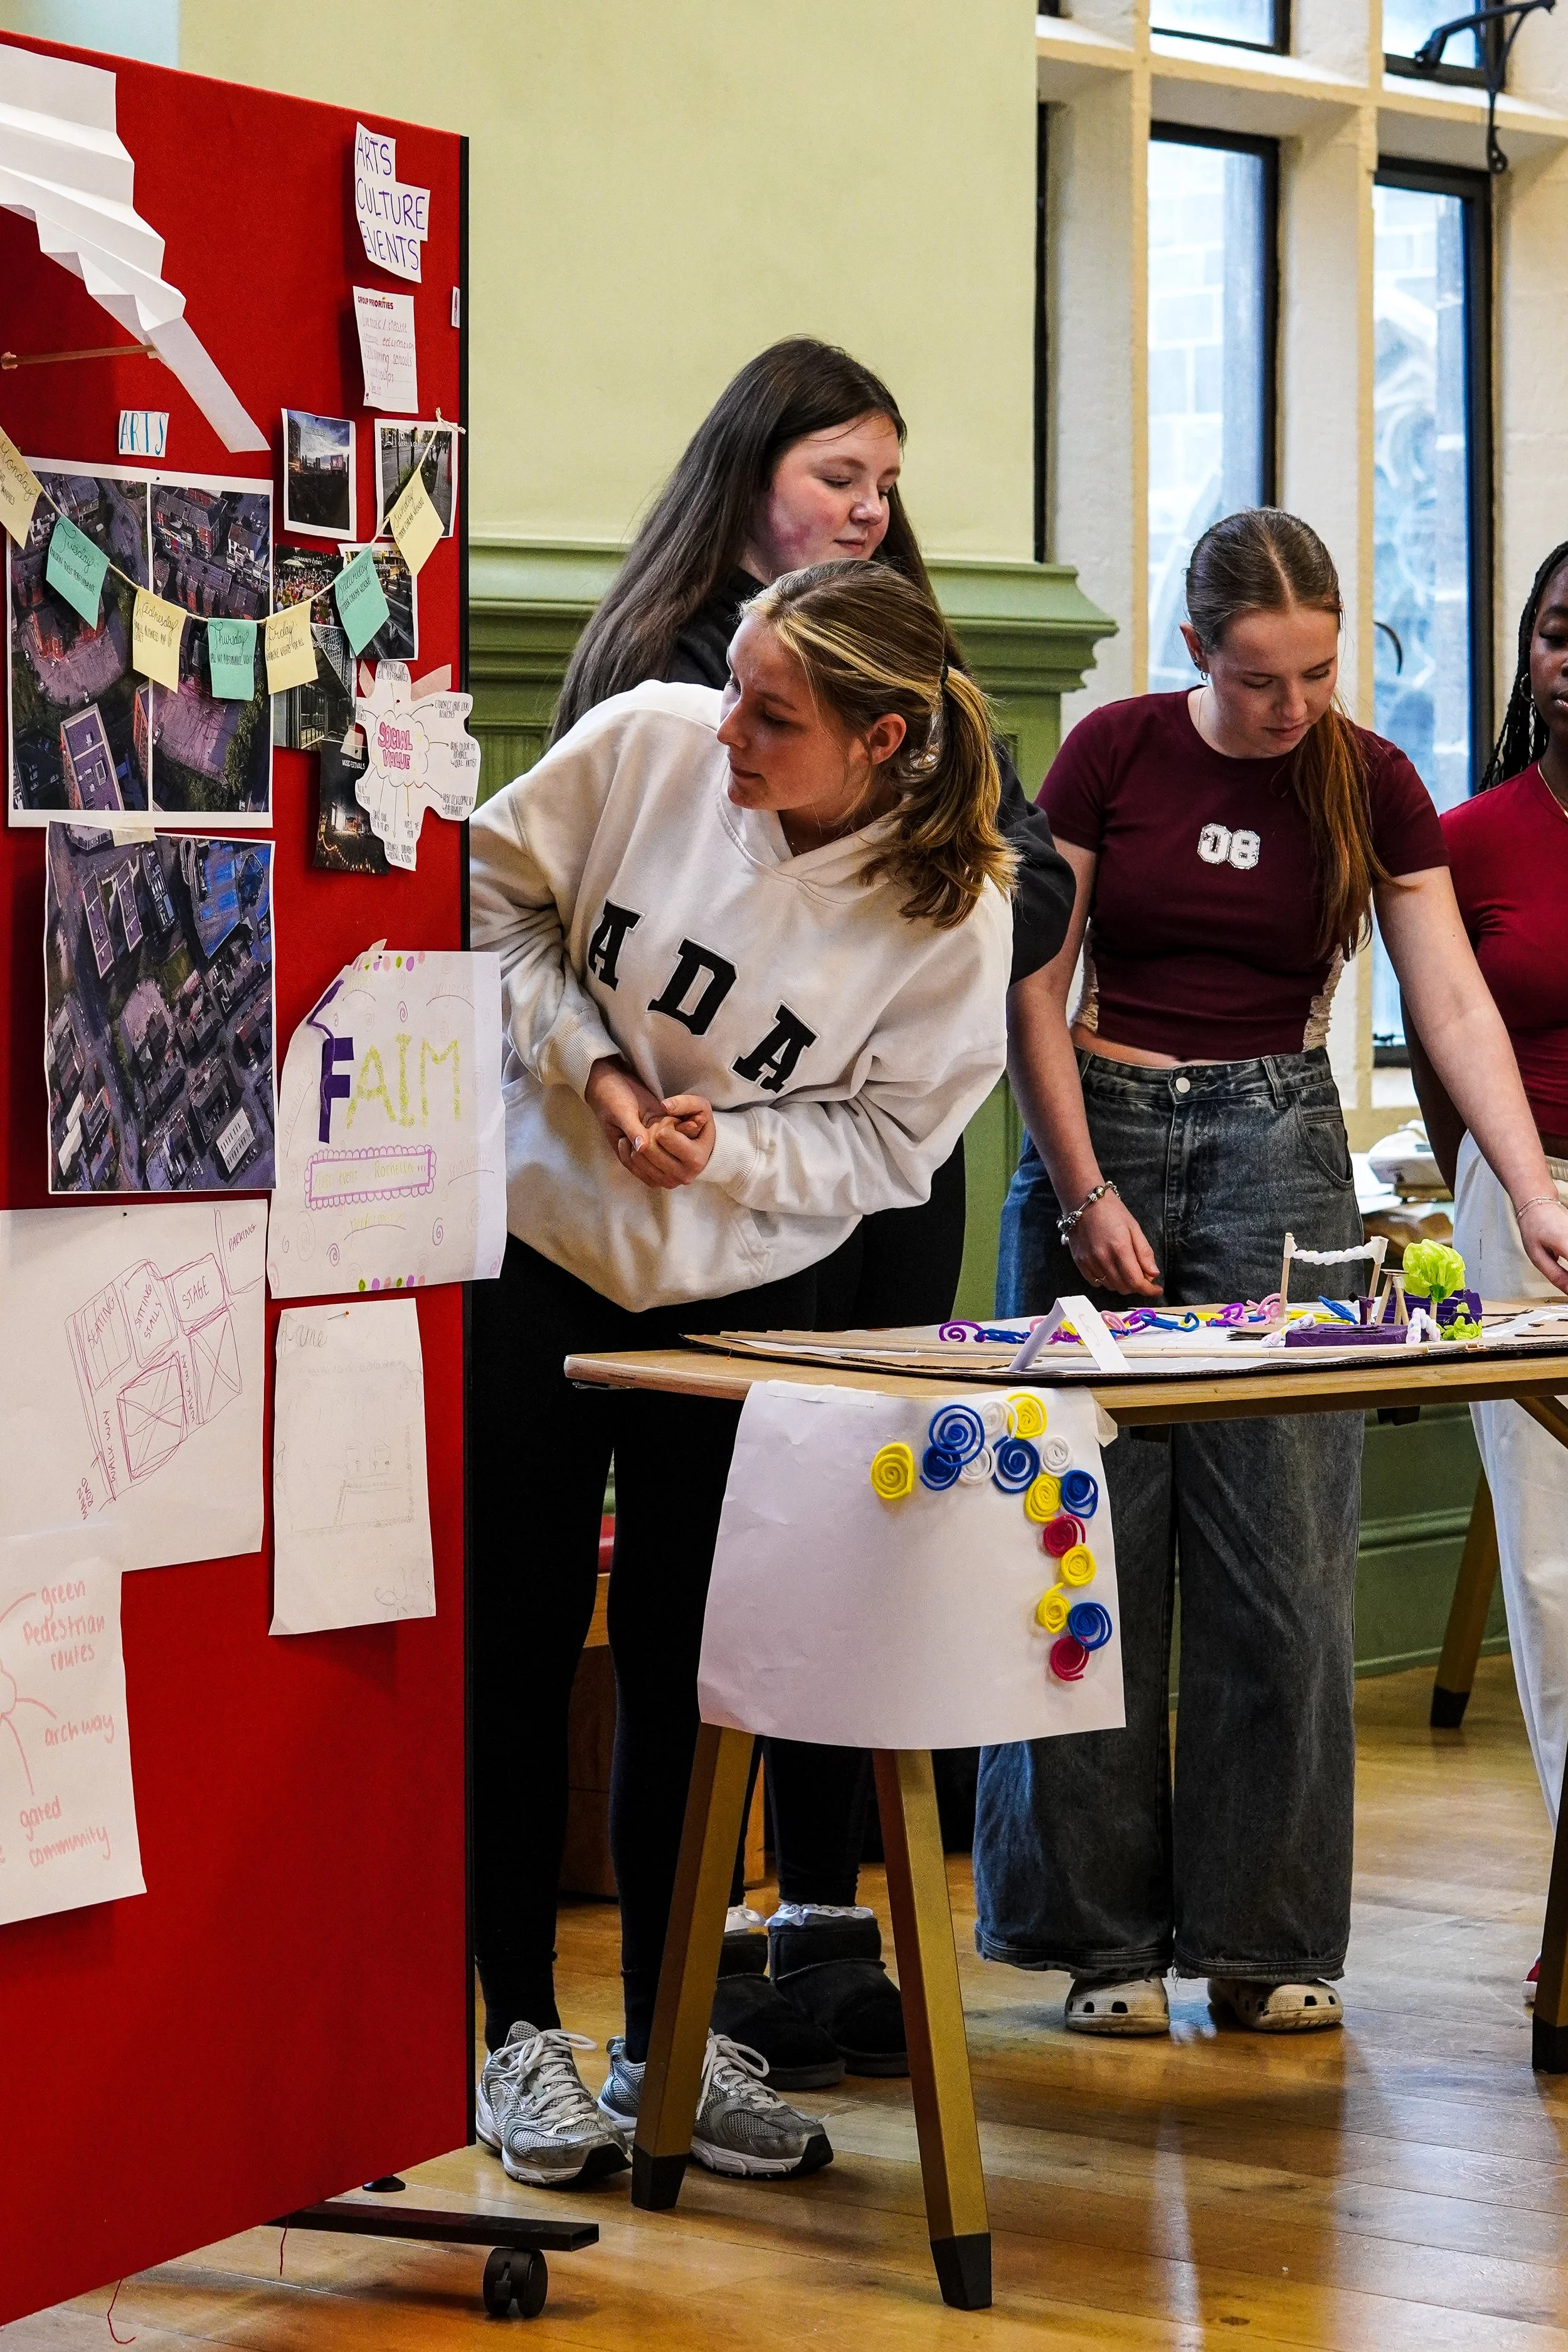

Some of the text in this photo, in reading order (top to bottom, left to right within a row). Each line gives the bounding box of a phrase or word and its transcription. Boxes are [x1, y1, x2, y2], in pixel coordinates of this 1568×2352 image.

[356, 132, 392, 175] ARTS
[356, 177, 425, 230] CULTURE
[359, 220, 419, 270] EVENTS
[358, 296, 394, 309] GROUP PRIORITIES
[382, 337, 415, 348] education
[393, 352, 413, 367] schools
[120, 411, 167, 455] ARTS
[327, 643, 341, 652] STOPS
[378, 721, 413, 751] SOCIAL
[383, 750, 411, 770] VALUE
[228, 1223, 257, 1253] PARKING
[134, 1283, 152, 1330] SITTING
[182, 1275, 210, 1310] STAGE
[87, 1296, 115, 1350] SEATING
[144, 1302, 162, 1340] STALLS
[181, 1354, 190, 1382] WAY
[102, 1409, 117, 1483] WALK WAY
[76, 1487, 89, 1521] MAIN
[81, 1477, 94, 1507] ROAD
[41, 1580, 86, 1621] green
[50, 1643, 95, 1672] routes
[29, 1826, 112, 1868] community
